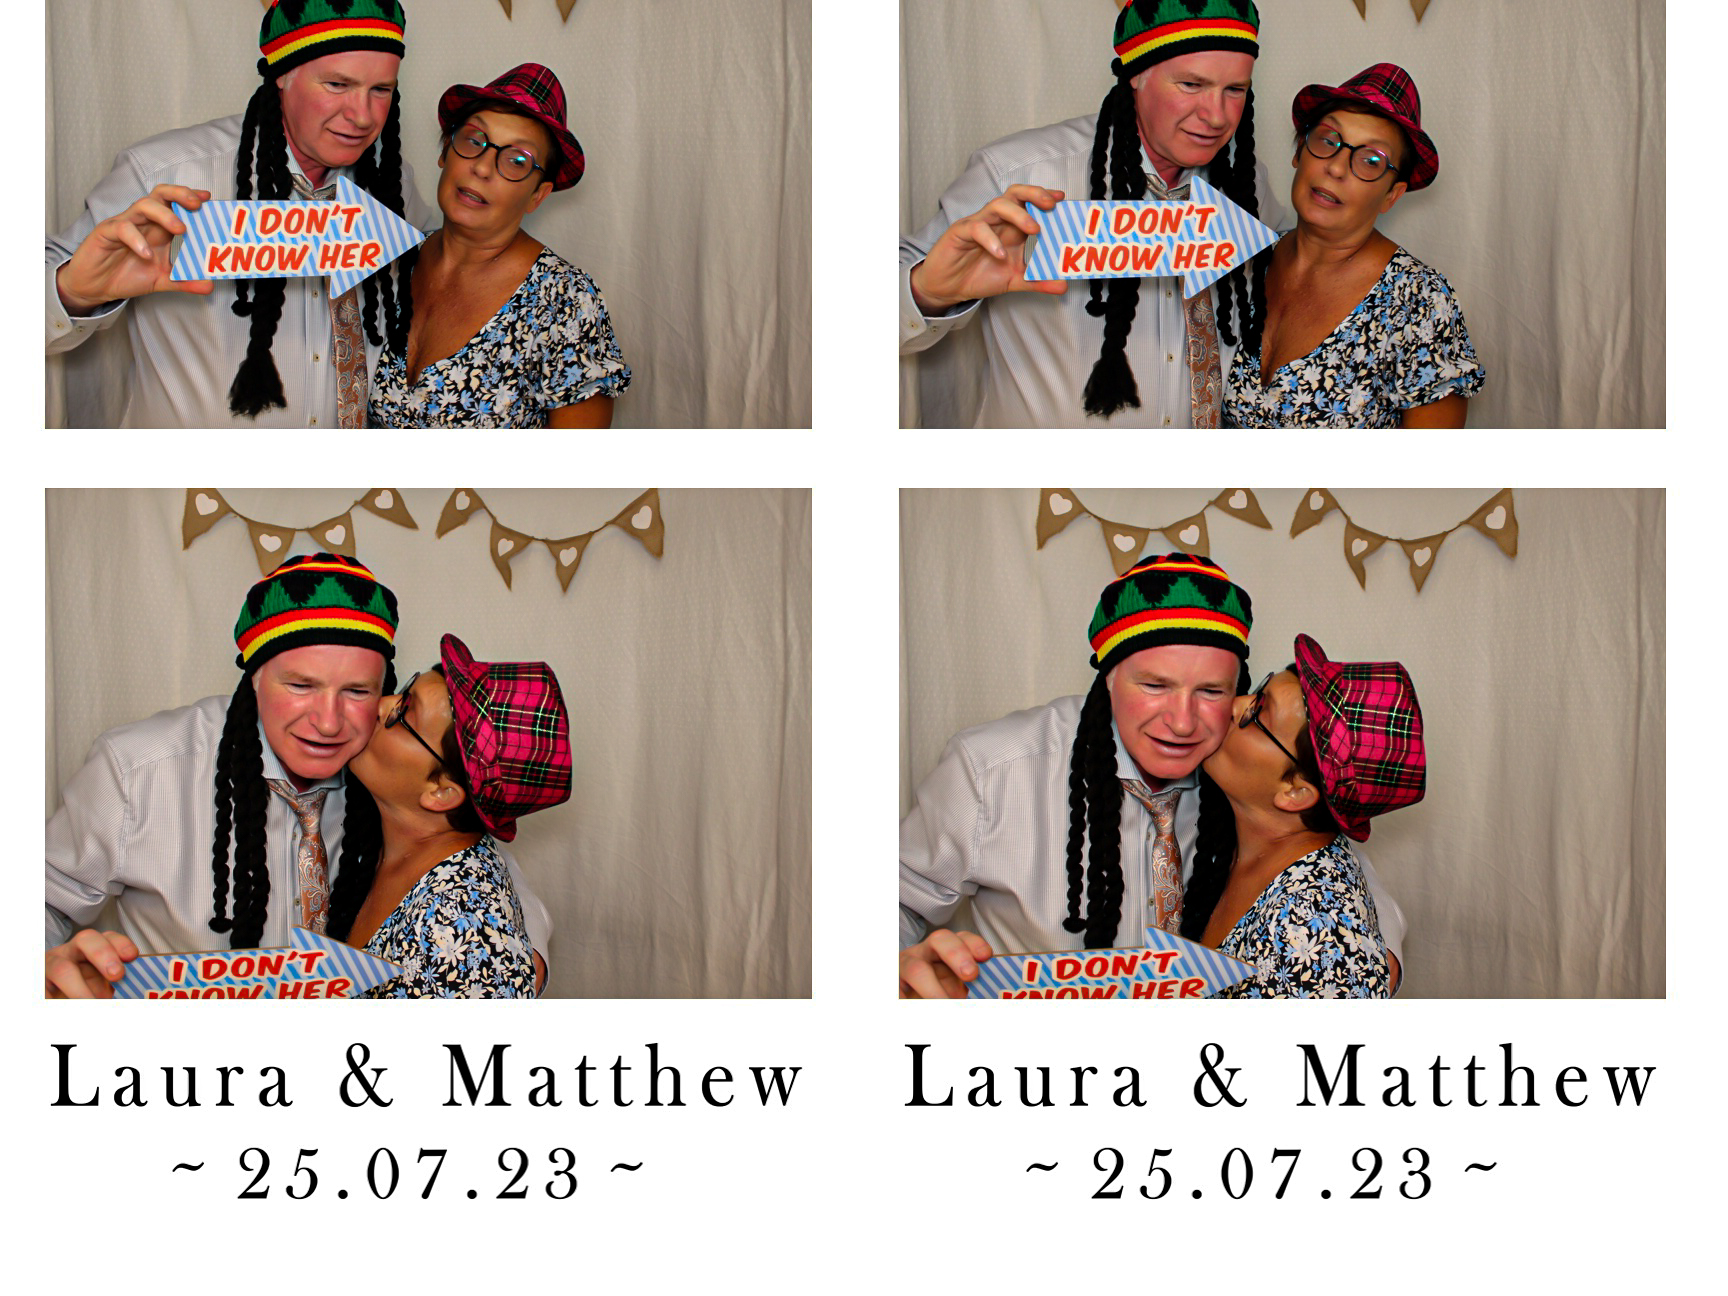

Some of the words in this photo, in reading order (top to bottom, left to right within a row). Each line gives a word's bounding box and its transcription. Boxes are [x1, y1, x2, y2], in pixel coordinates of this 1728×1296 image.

[233, 207, 247, 235] I
[259, 203, 363, 235] DON'T
[1087, 207, 1101, 235] I
[1113, 203, 1217, 235] DON'T
[207, 243, 311, 273] KNOW
[319, 241, 381, 270] HER
[1061, 243, 1165, 273] KNOW
[1173, 241, 1235, 270] HER
[171, 961, 184, 983] I
[201, 950, 326, 981] DON'T
[1025, 961, 1038, 983] I
[1055, 950, 1180, 981] DON'T
[278, 978, 351, 999] HER
[1132, 978, 1205, 999] HER
